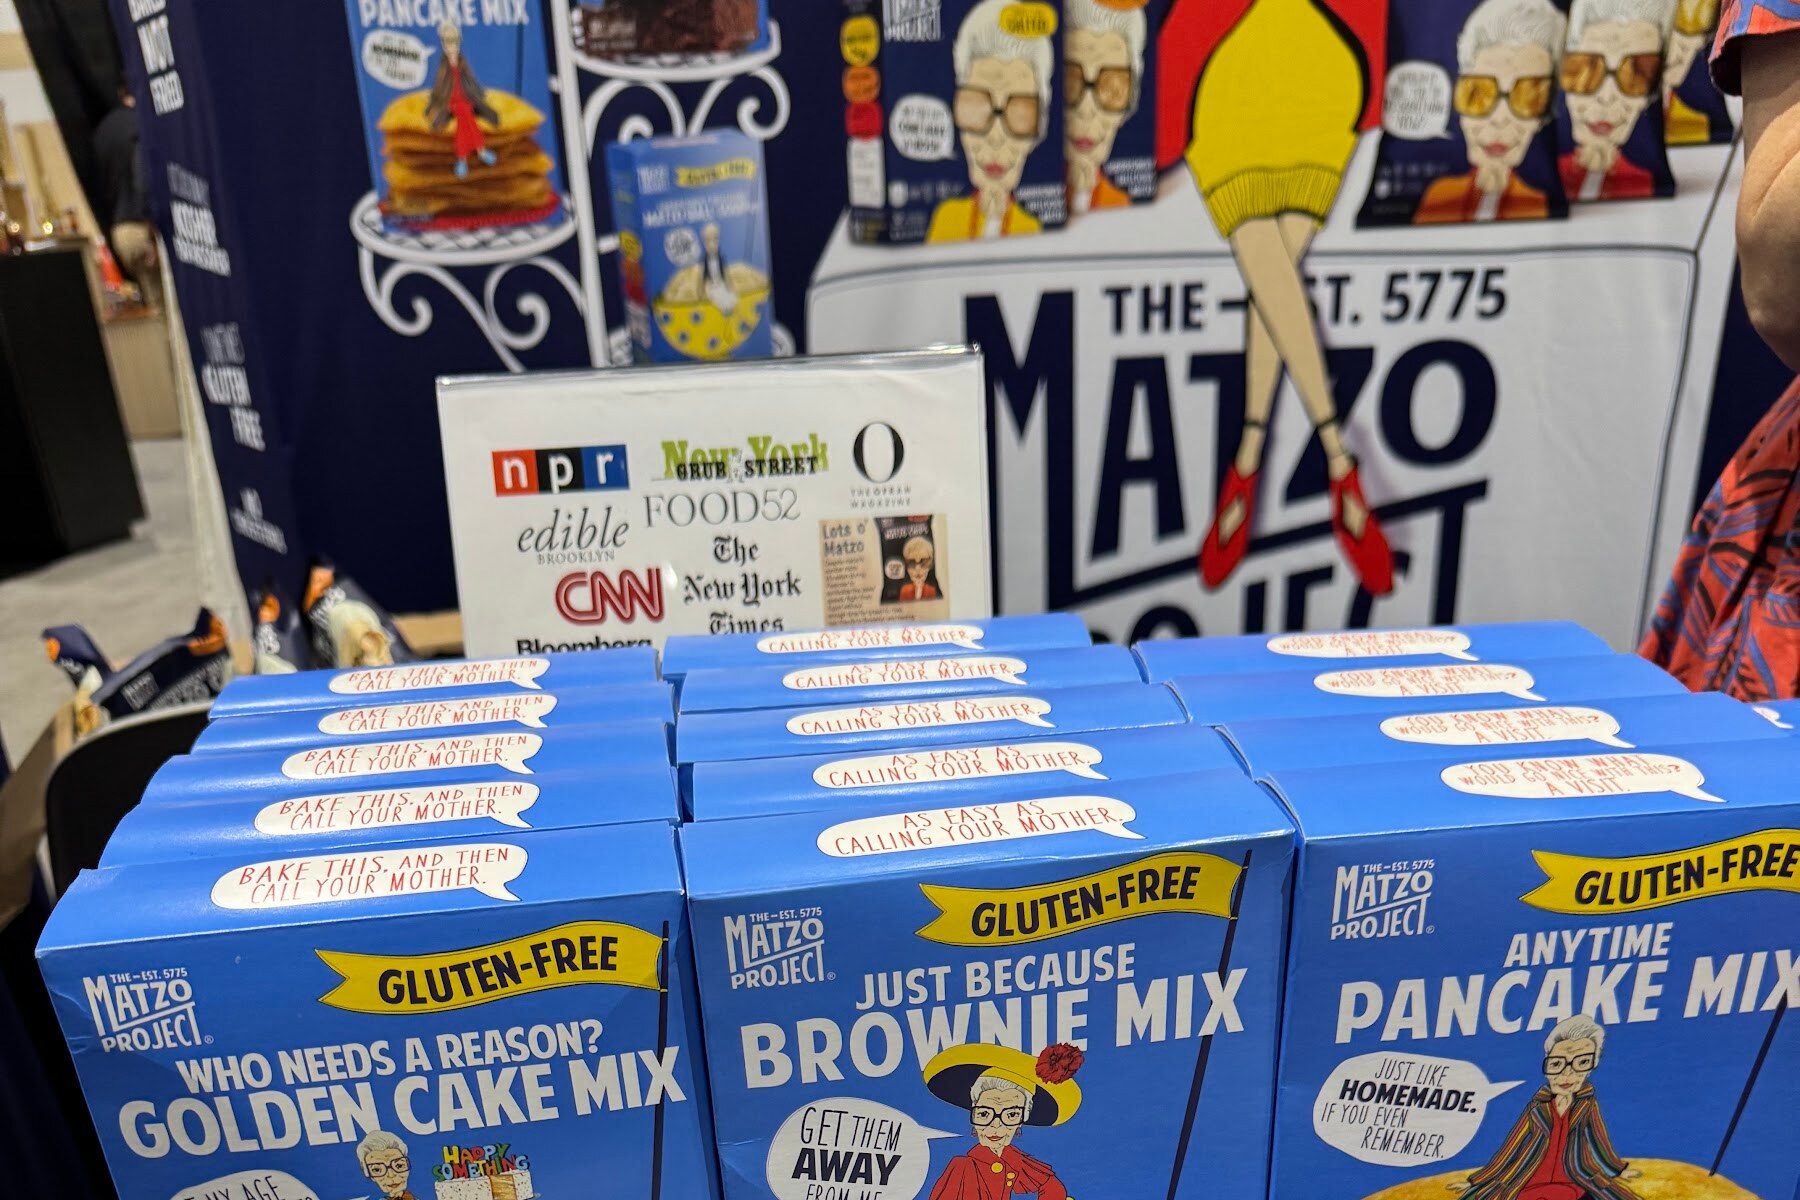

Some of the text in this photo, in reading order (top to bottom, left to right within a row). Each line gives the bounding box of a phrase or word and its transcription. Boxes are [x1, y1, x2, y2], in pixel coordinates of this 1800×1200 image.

[1383, 267, 1507, 322] 5775
[661, 433, 830, 479] New York
[743, 456, 818, 478] STREET
[852, 421, 905, 484] O
[502, 451, 614, 495] npr
[643, 488, 801, 528] FOOD52
[517, 506, 629, 552] edible
[823, 522, 852, 540] Lots
[537, 550, 615, 565] BROOKLYN
[713, 535, 759, 566] The
[824, 541, 865, 556] Matzo
[555, 567, 665, 625] CNN
[684, 574, 735, 606] New
[741, 569, 802, 606] York
[709, 611, 785, 635] Times
[829, 750, 1090, 787] CALLING YOUR MOTHER.
[891, 745, 1022, 767] AS EASY AS
[1459, 763, 1681, 787] WOULD GO NICE WITH THIS?
[1464, 753, 1650, 776] YOU KNOW WHAT
[1544, 777, 1631, 796] A VISIT.
[835, 807, 1124, 857] CALLING YOUR MOTHER.
[903, 801, 1045, 829] AS EASY AS
[239, 861, 312, 885] BAKE
[399, 852, 444, 869] AND
[456, 847, 510, 865] THEN
[1412, 858, 1435, 870] 5775
[1575, 842, 1800, 906] GLUTEN-FREE
[250, 866, 487, 904] CALL YOUR MOTHER.
[972, 866, 1201, 939] GLUTEN-FREE
[1332, 866, 1432, 926] MATZO
[800, 907, 822, 918] 5775
[724, 914, 825, 974] MATZO
[1503, 922, 1673, 968] ANYTIME
[163, 967, 188, 979] 5775
[379, 936, 618, 1005] GLUTEN-FREE
[856, 943, 1136, 1010] JUST BECAUSE
[83, 975, 193, 1037] MATZO
[1335, 949, 1800, 1044] PANCAKE MIX
[740, 968, 1248, 1090] BROWNIE MIX
[175, 1019, 603, 1094] WHO NEEDS A REASON?
[1375, 1058, 1450, 1087] JUST LIKE
[118, 1045, 688, 1159] GOLDEN CAKE MIX
[1339, 1078, 1477, 1114] HOMEMADE.
[801, 1106, 903, 1152] GET THEM
[1321, 1102, 1409, 1129] IF YOU EVEN
[442, 1143, 511, 1164] HAPPY
[1360, 1126, 1445, 1159] REMEMBER.
[431, 1154, 530, 1182] SOMETHING
[791, 1148, 902, 1186] AWAY
